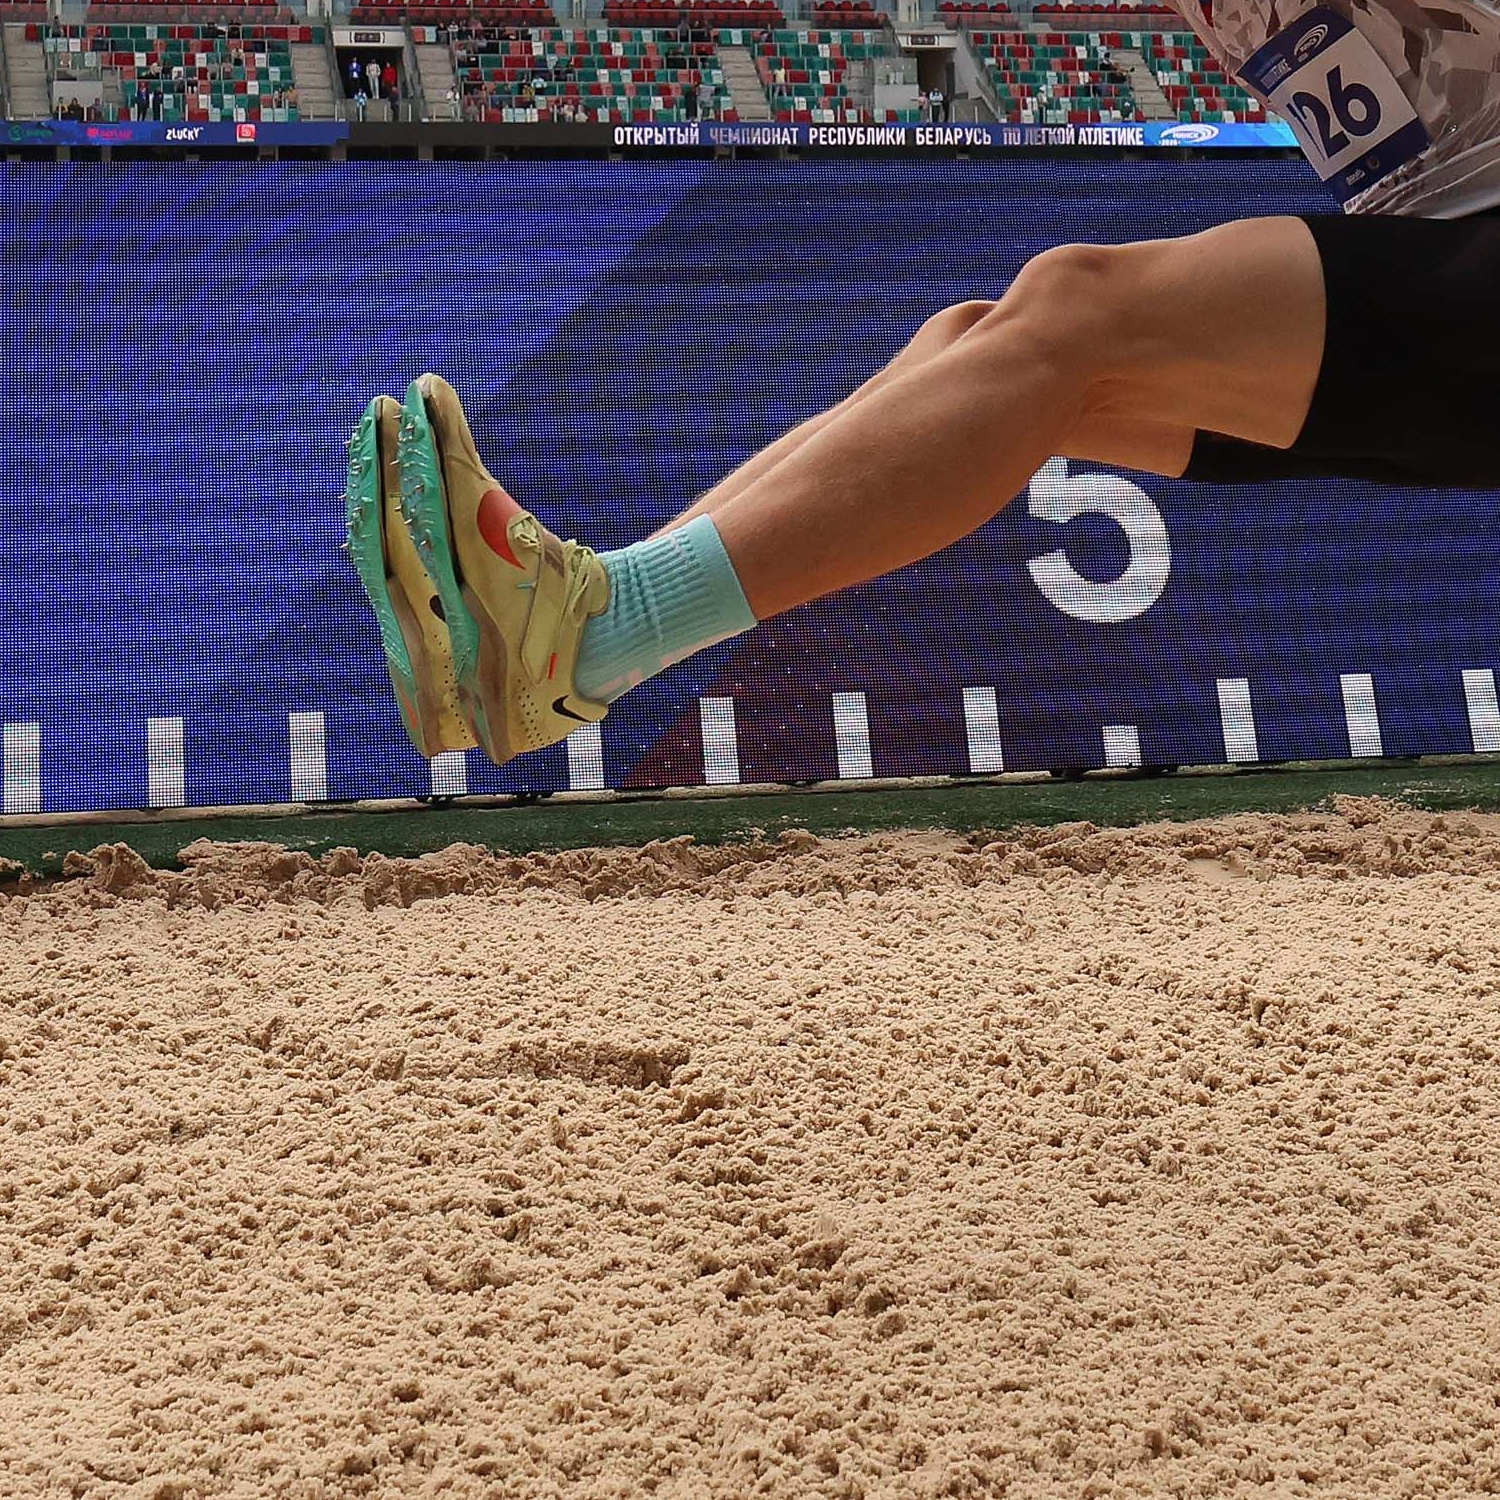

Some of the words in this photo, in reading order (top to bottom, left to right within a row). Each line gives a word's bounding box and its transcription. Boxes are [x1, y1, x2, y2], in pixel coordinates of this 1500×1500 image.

[614, 123, 699, 145] ОТКРЫТЫЙ
[709, 127, 799, 145] ЧЕМПИОНАТ
[809, 127, 905, 145] РЕСПУБЛИКИ
[915, 128, 991, 146] БЕЛАРУСЬ
[1003, 127, 1021, 145] ПО
[1024, 124, 1075, 146] ЛЕГКОЙ
[1078, 127, 1144, 146] АТЛЕТИКЕ
[1026, 456, 1171, 623] 5
